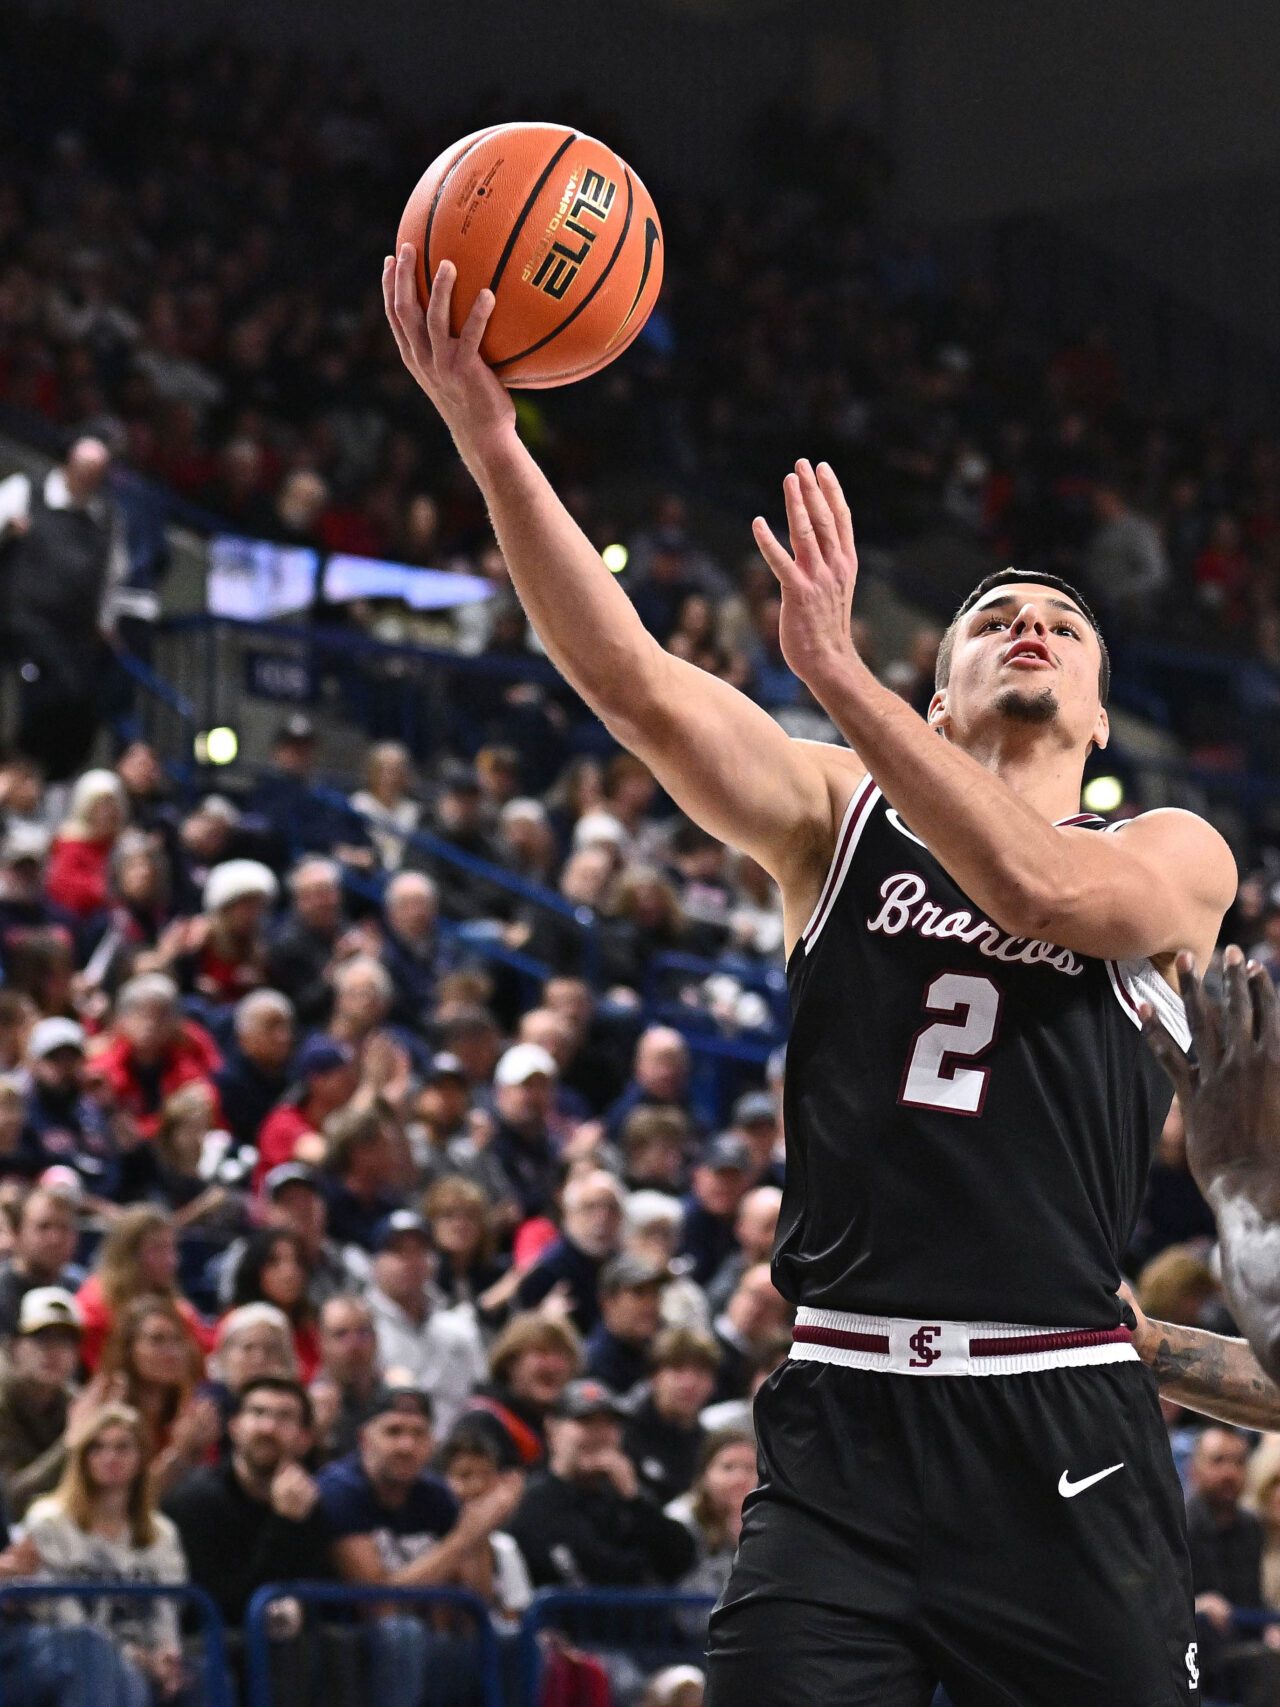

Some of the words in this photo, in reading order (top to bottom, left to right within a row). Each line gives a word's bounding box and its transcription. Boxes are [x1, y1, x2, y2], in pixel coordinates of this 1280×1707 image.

[521, 164, 586, 281] HAMPIONIP
[531, 168, 617, 300] ELITE
[866, 872, 1084, 976] Broncos
[898, 970, 1001, 1116] 2
